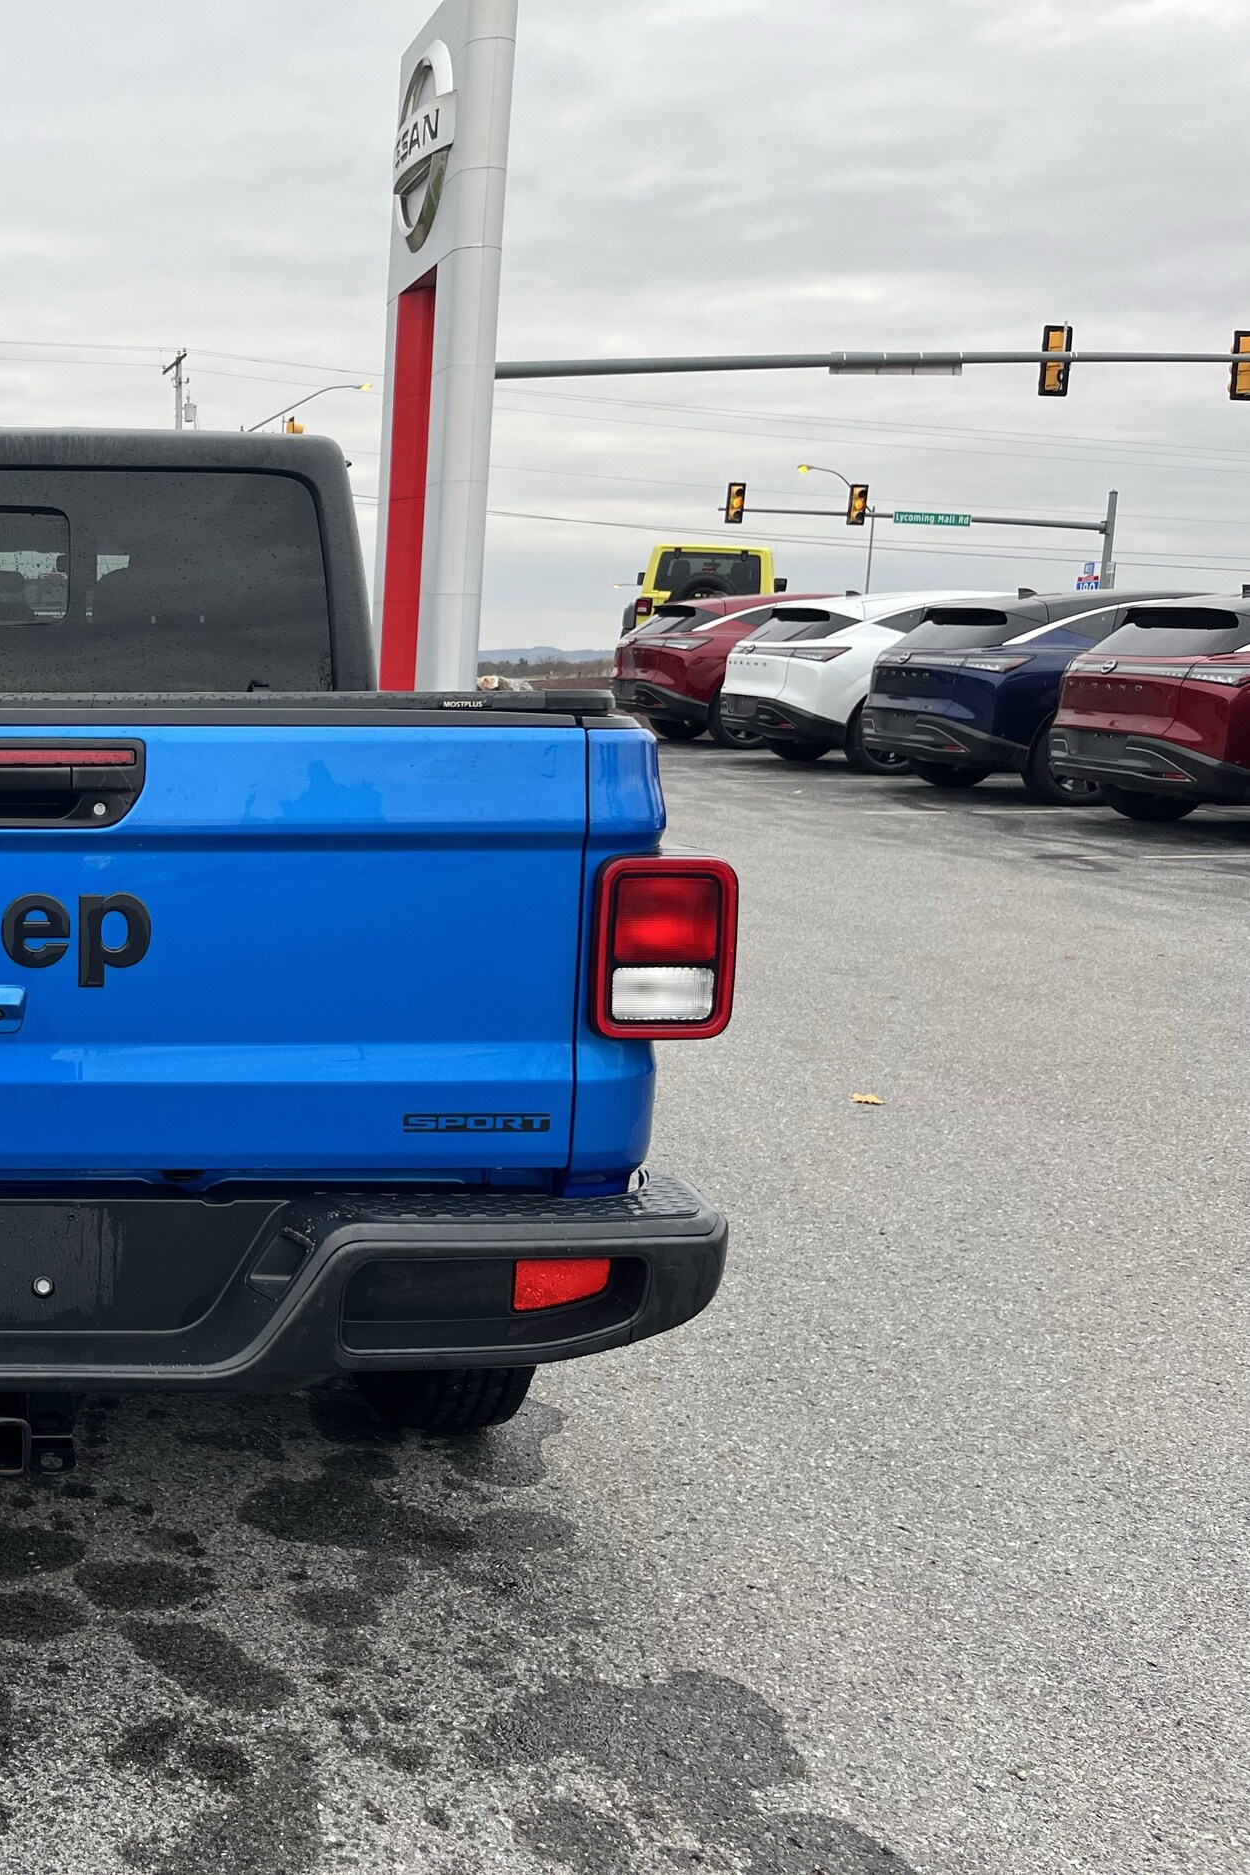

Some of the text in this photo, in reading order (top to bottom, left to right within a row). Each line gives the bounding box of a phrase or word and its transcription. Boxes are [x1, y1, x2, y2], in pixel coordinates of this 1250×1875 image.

[394, 108, 440, 169] SSAN
[895, 513, 969, 525] Lycoming Mall Rd
[443, 700, 483, 708] MOSTPLUS
[403, 1114, 550, 1132] SPORT
